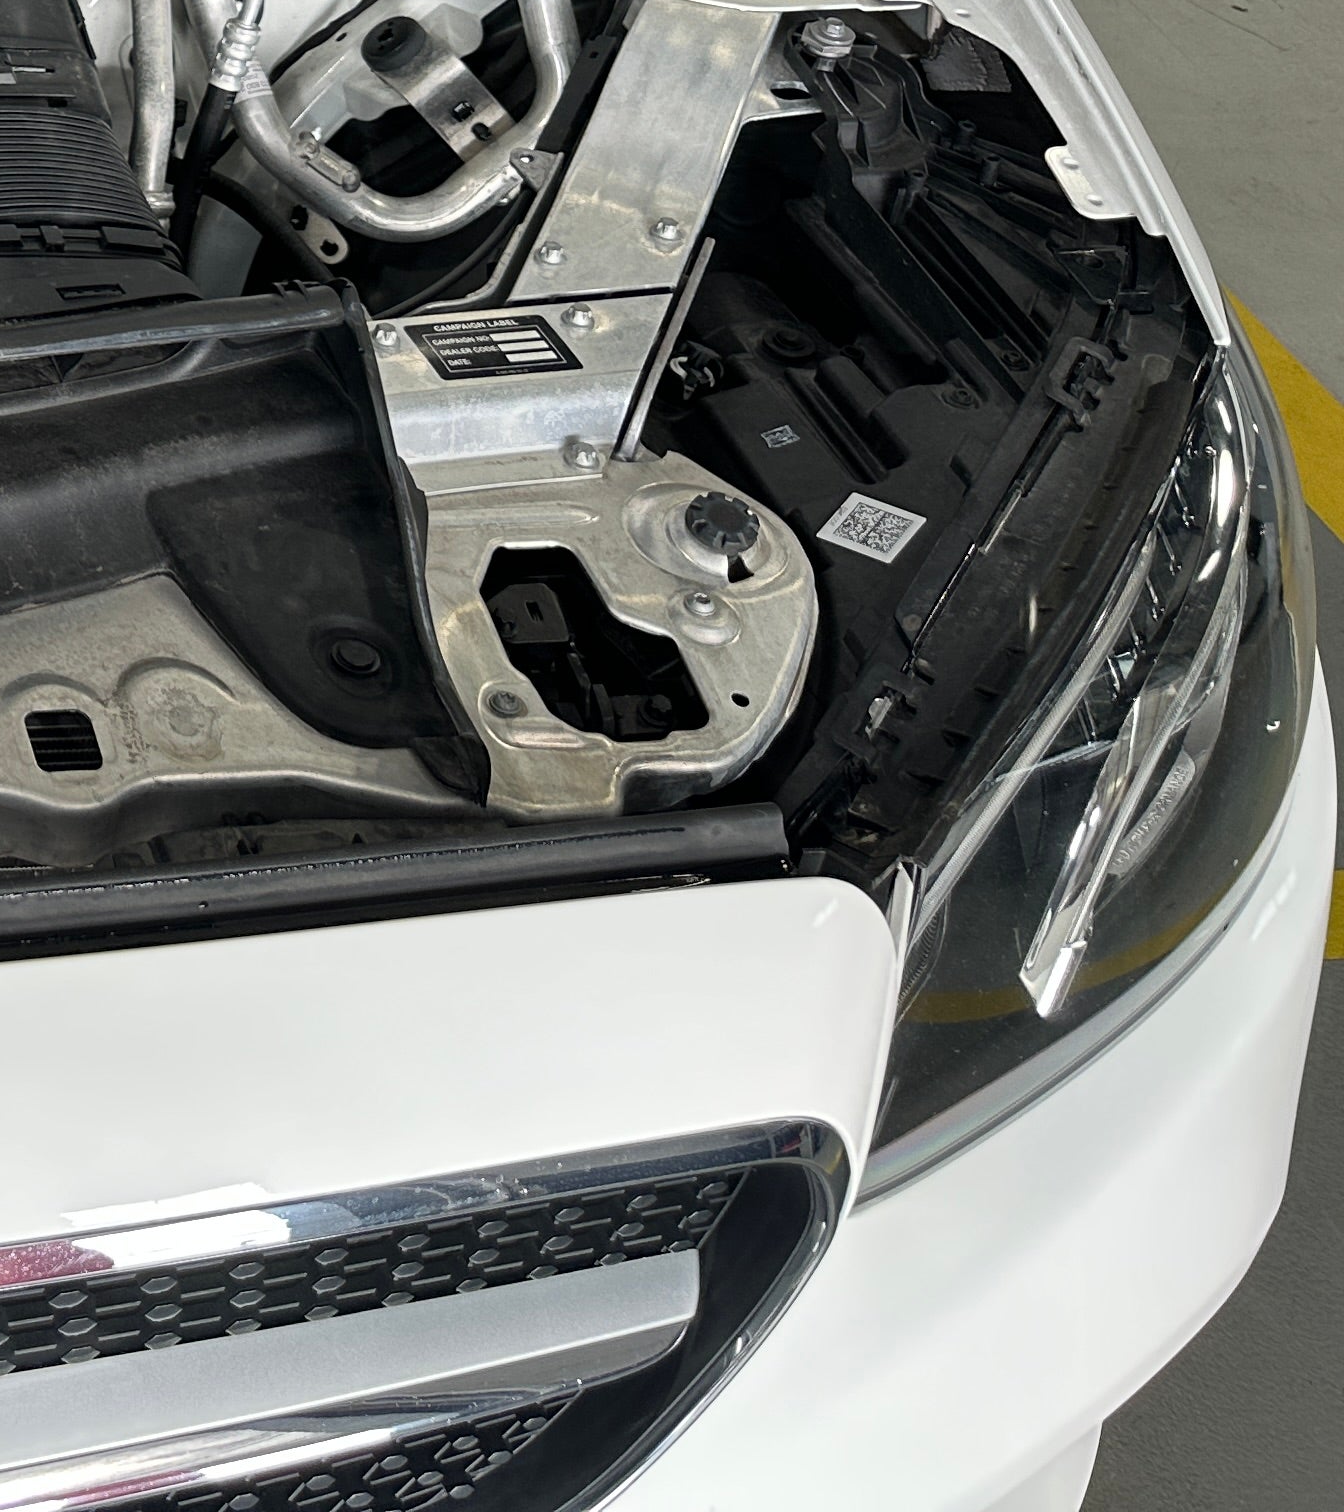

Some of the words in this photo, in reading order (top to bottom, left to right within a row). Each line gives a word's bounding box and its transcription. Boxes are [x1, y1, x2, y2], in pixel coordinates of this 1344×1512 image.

[433, 321, 486, 332] CAMPAIGN
[486, 319, 518, 328] LABEL
[432, 336, 475, 346] CAMPAIGN
[439, 347, 472, 356] DEALER
[447, 358, 472, 366] DATE:
